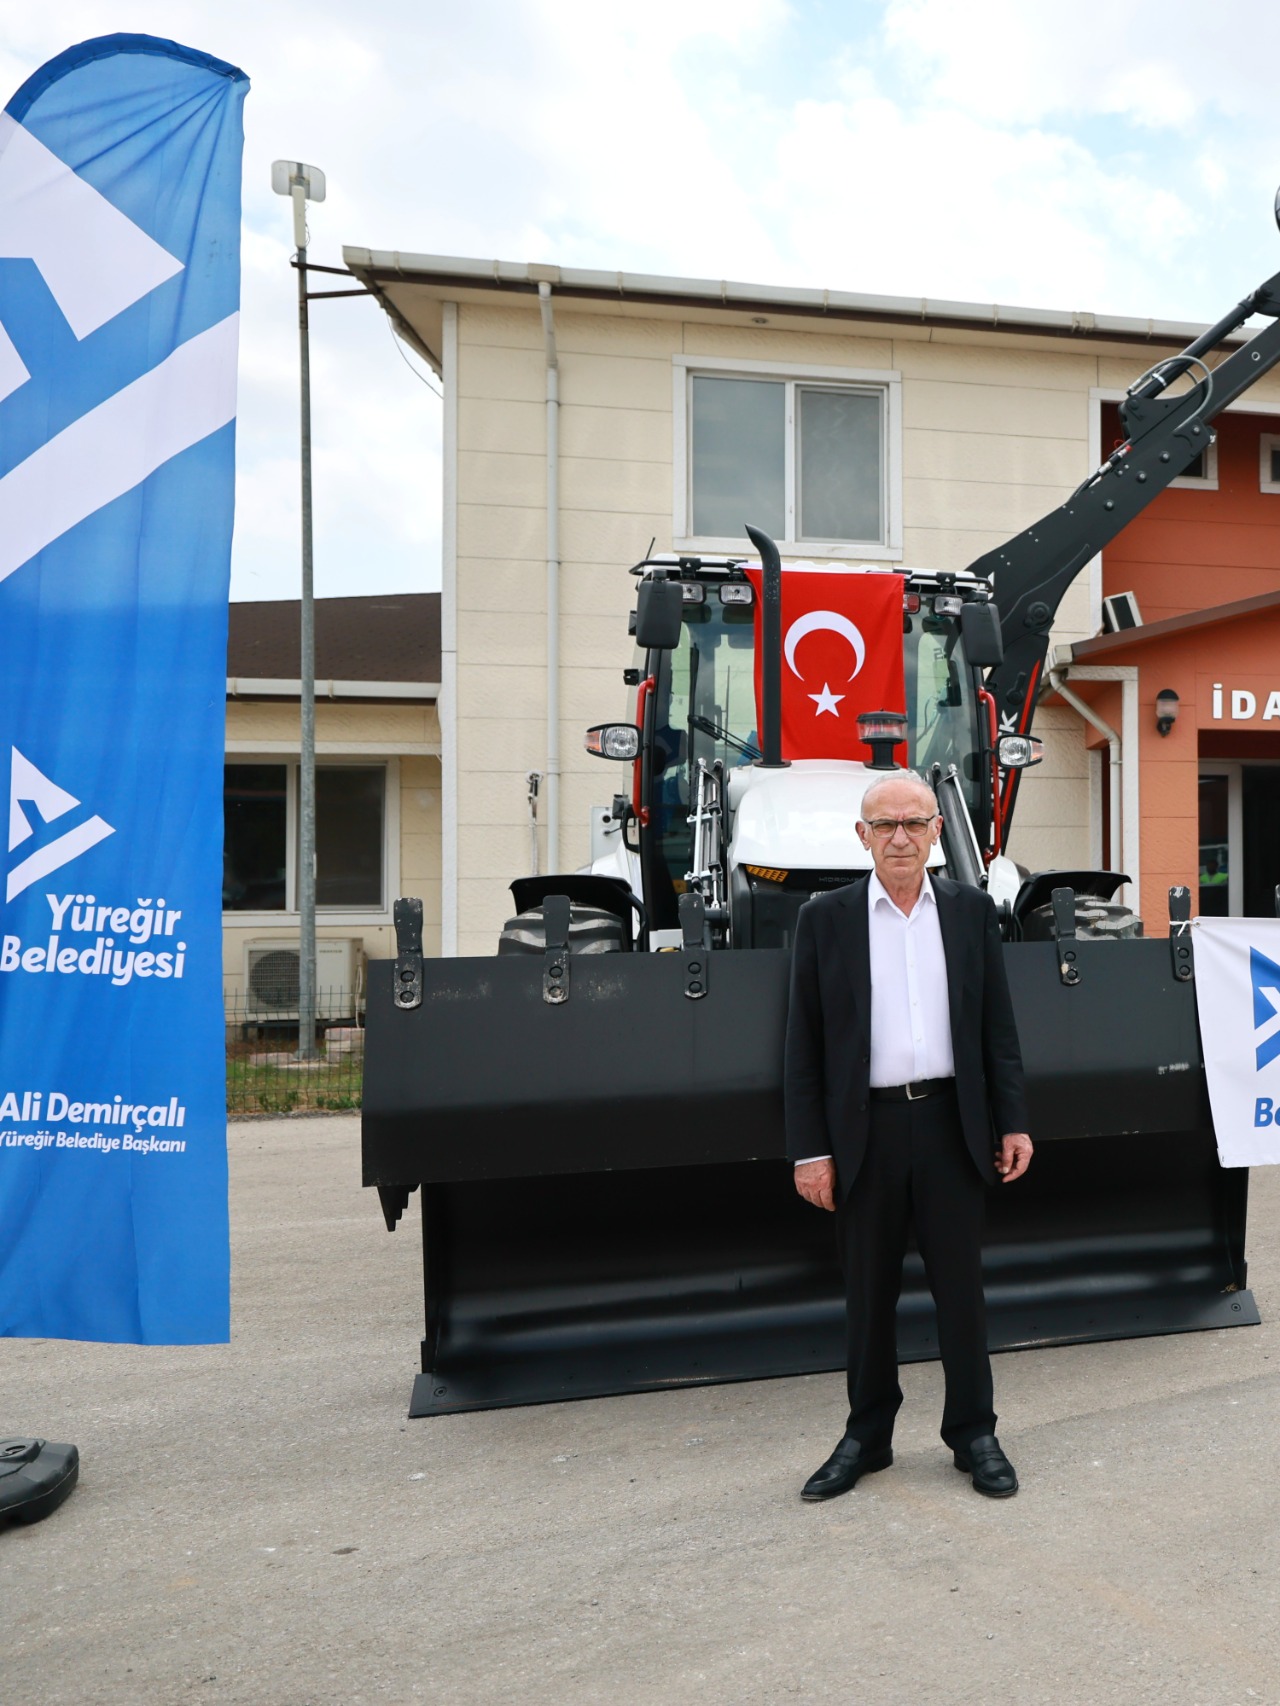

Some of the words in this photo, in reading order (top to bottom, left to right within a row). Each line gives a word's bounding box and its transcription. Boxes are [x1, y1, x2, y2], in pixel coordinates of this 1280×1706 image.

[45, 893, 182, 944] Yüreğir
[0, 935, 187, 986] Belediyesi
[0, 1091, 42, 1122] Ali
[46, 1092, 186, 1133] Demirçalı
[55, 1132, 120, 1153] Belediye
[122, 1134, 186, 1155] Başkanı
